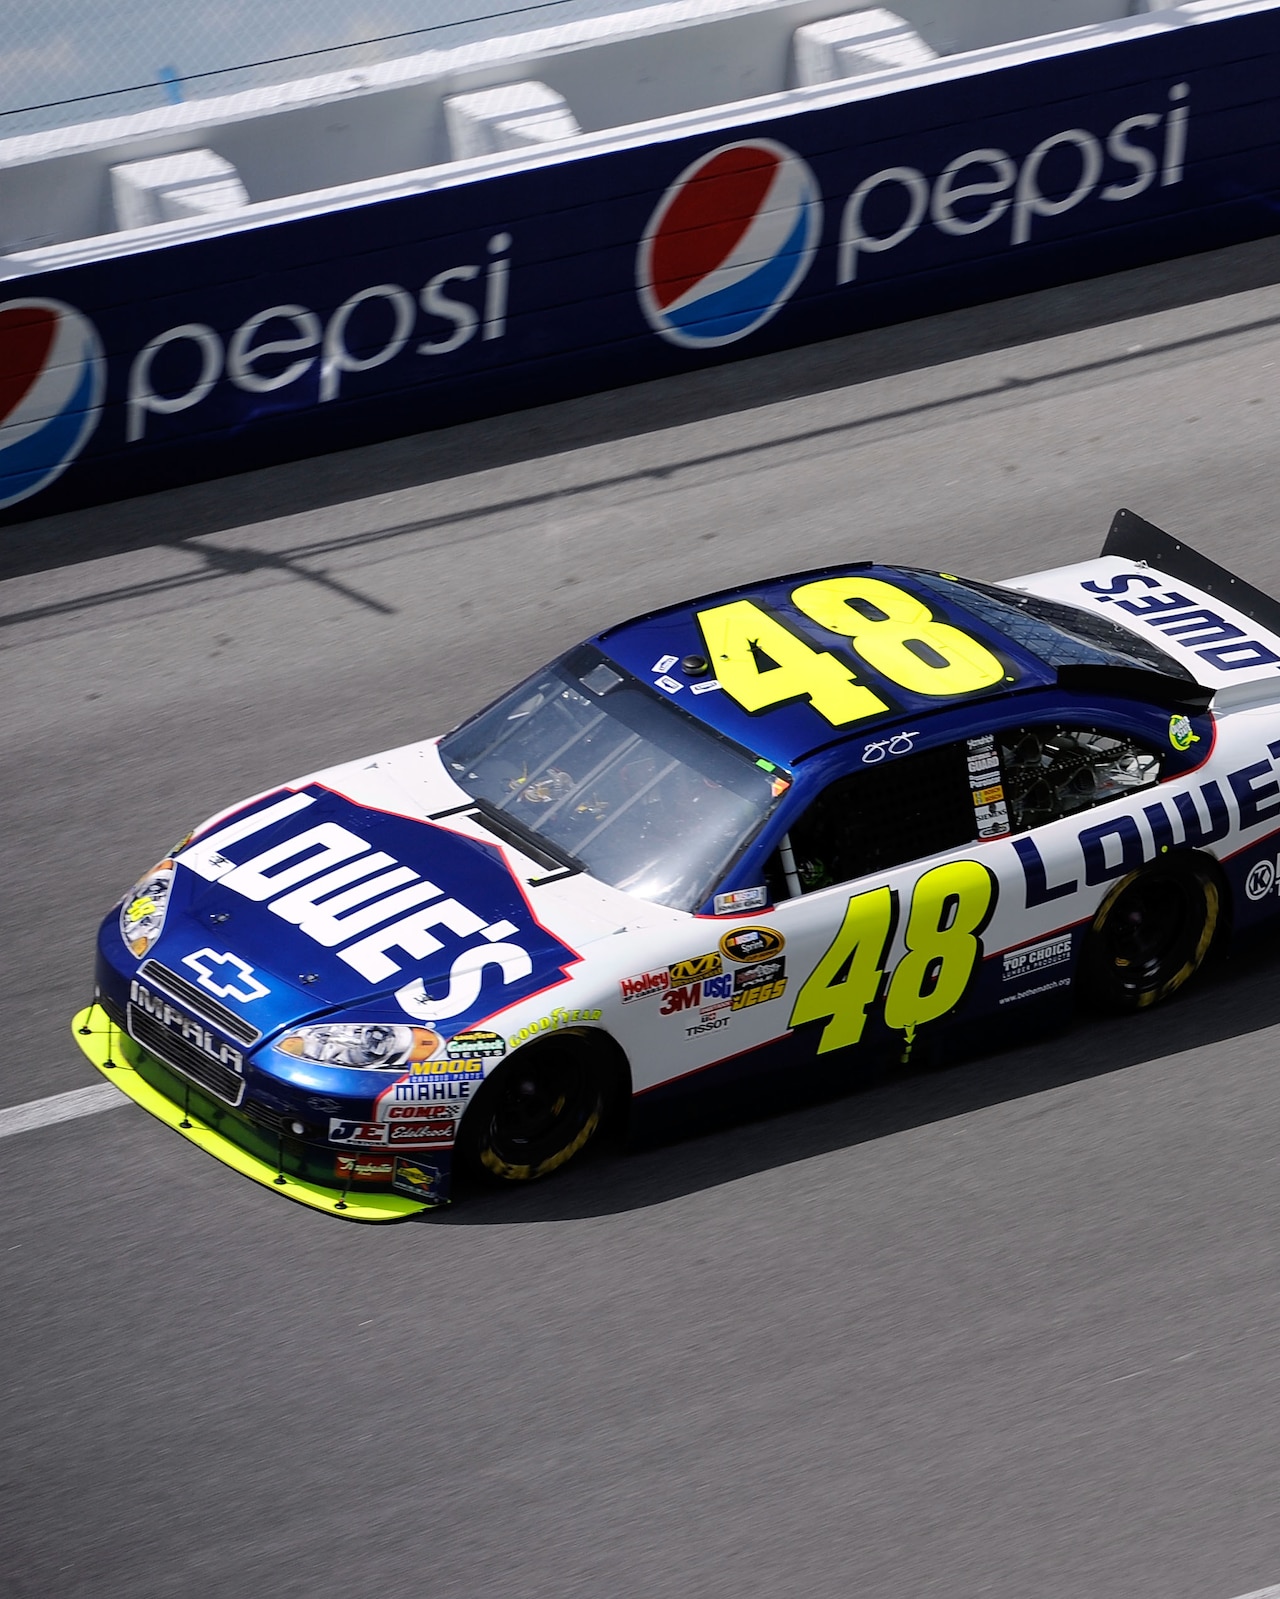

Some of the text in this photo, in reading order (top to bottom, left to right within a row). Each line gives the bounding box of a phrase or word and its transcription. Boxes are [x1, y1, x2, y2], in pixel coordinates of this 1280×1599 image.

[836, 82, 1190, 285] pepsi
[125, 232, 512, 443] pepsi
[695, 577, 1007, 730] 48
[968, 756, 1000, 772] GUARD
[976, 809, 1007, 821] SIEMENS
[173, 792, 534, 1021] LOWE'S
[741, 940, 764, 953] Sprint
[788, 859, 994, 1055] 48
[1003, 941, 1072, 971] TOP CHOICE
[621, 972, 669, 996] Holley
[703, 974, 732, 999] USG
[731, 977, 788, 1011] JEGS
[660, 982, 701, 1015] 3M
[130, 979, 243, 1073] IMPALA
[508, 1007, 603, 1048] GOODYEAR
[685, 1017, 730, 1036] TISSOT
[450, 1050, 502, 1058] BELTS
[409, 1058, 482, 1075] MOOG
[395, 1082, 470, 1100] MAHLE
[388, 1105, 446, 1118] COMP
[330, 1121, 387, 1140] JE
[391, 1125, 453, 1138] Edelbrock
